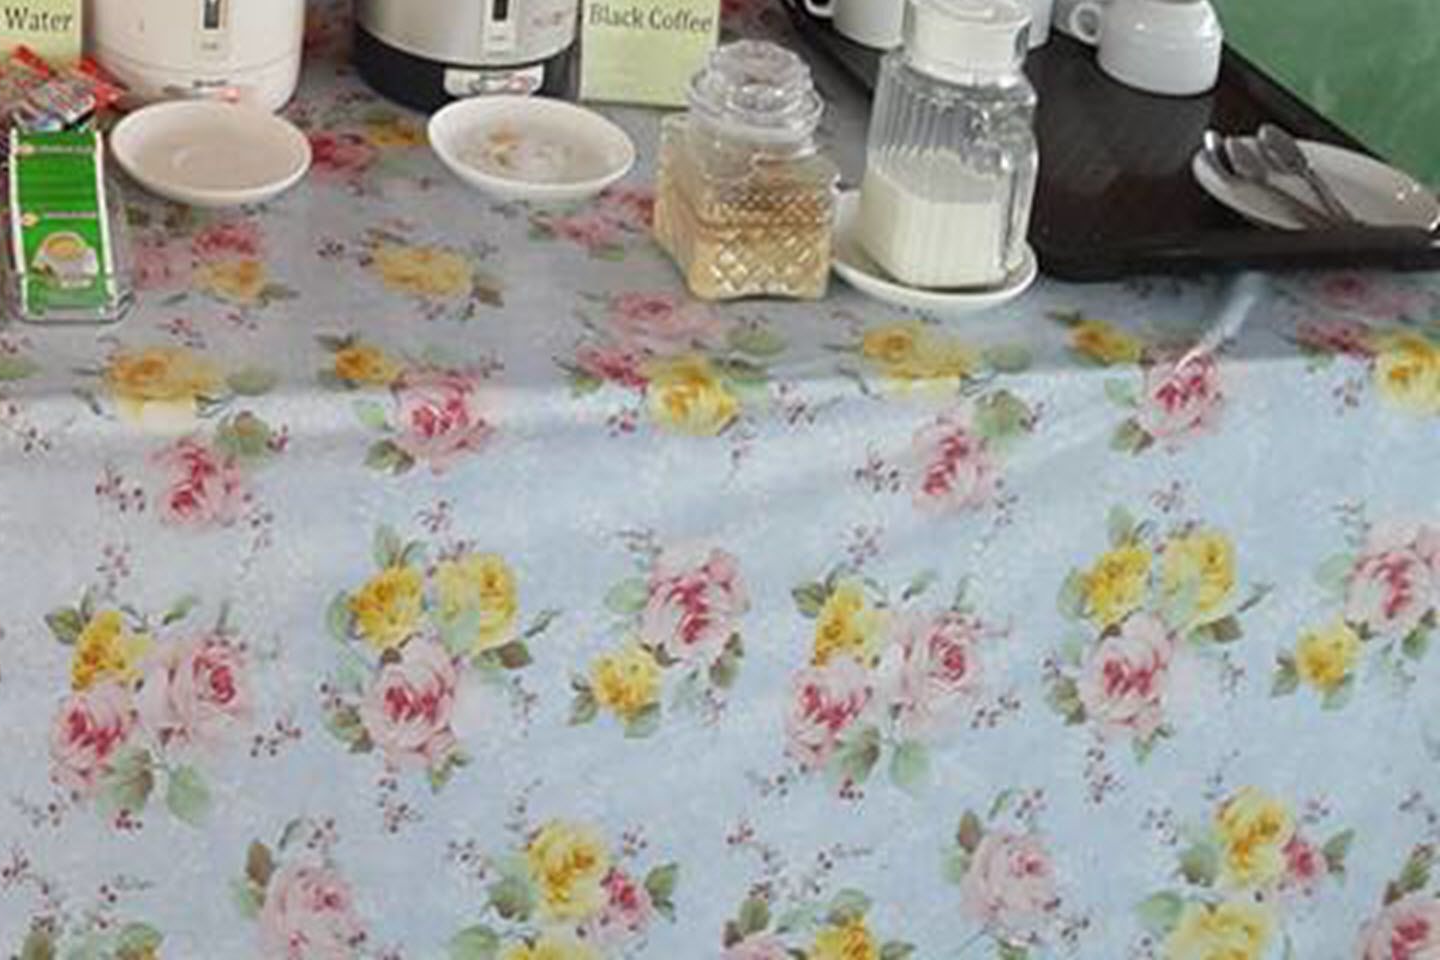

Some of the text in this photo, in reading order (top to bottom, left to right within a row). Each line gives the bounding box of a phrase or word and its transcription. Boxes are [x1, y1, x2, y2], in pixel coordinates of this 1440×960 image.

[4, 6, 72, 32] Water
[589, 2, 643, 30] Black
[649, 4, 713, 33] Coffee
